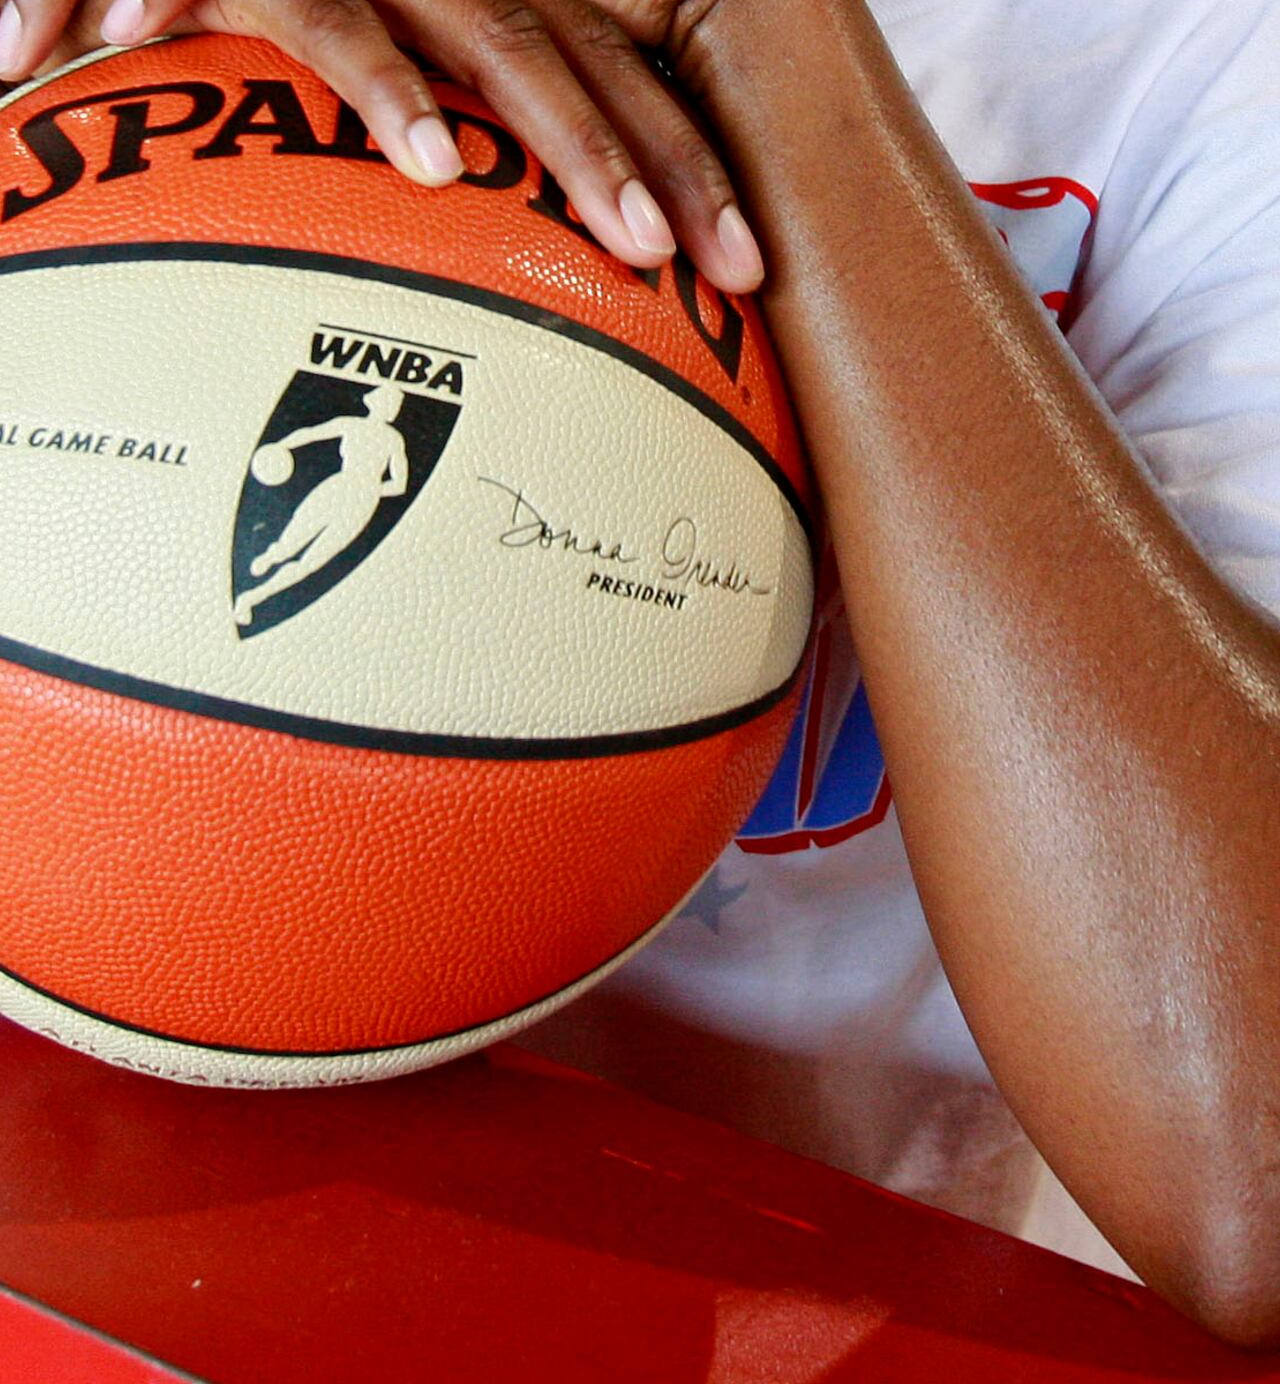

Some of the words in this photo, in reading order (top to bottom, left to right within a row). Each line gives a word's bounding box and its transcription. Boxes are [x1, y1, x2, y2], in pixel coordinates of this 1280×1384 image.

[311, 332, 463, 396] WNBA
[28, 428, 110, 455] GAME
[116, 438, 189, 466] BALL
[477, 476, 639, 564] Donna
[586, 573, 688, 611] PRESIDENT
